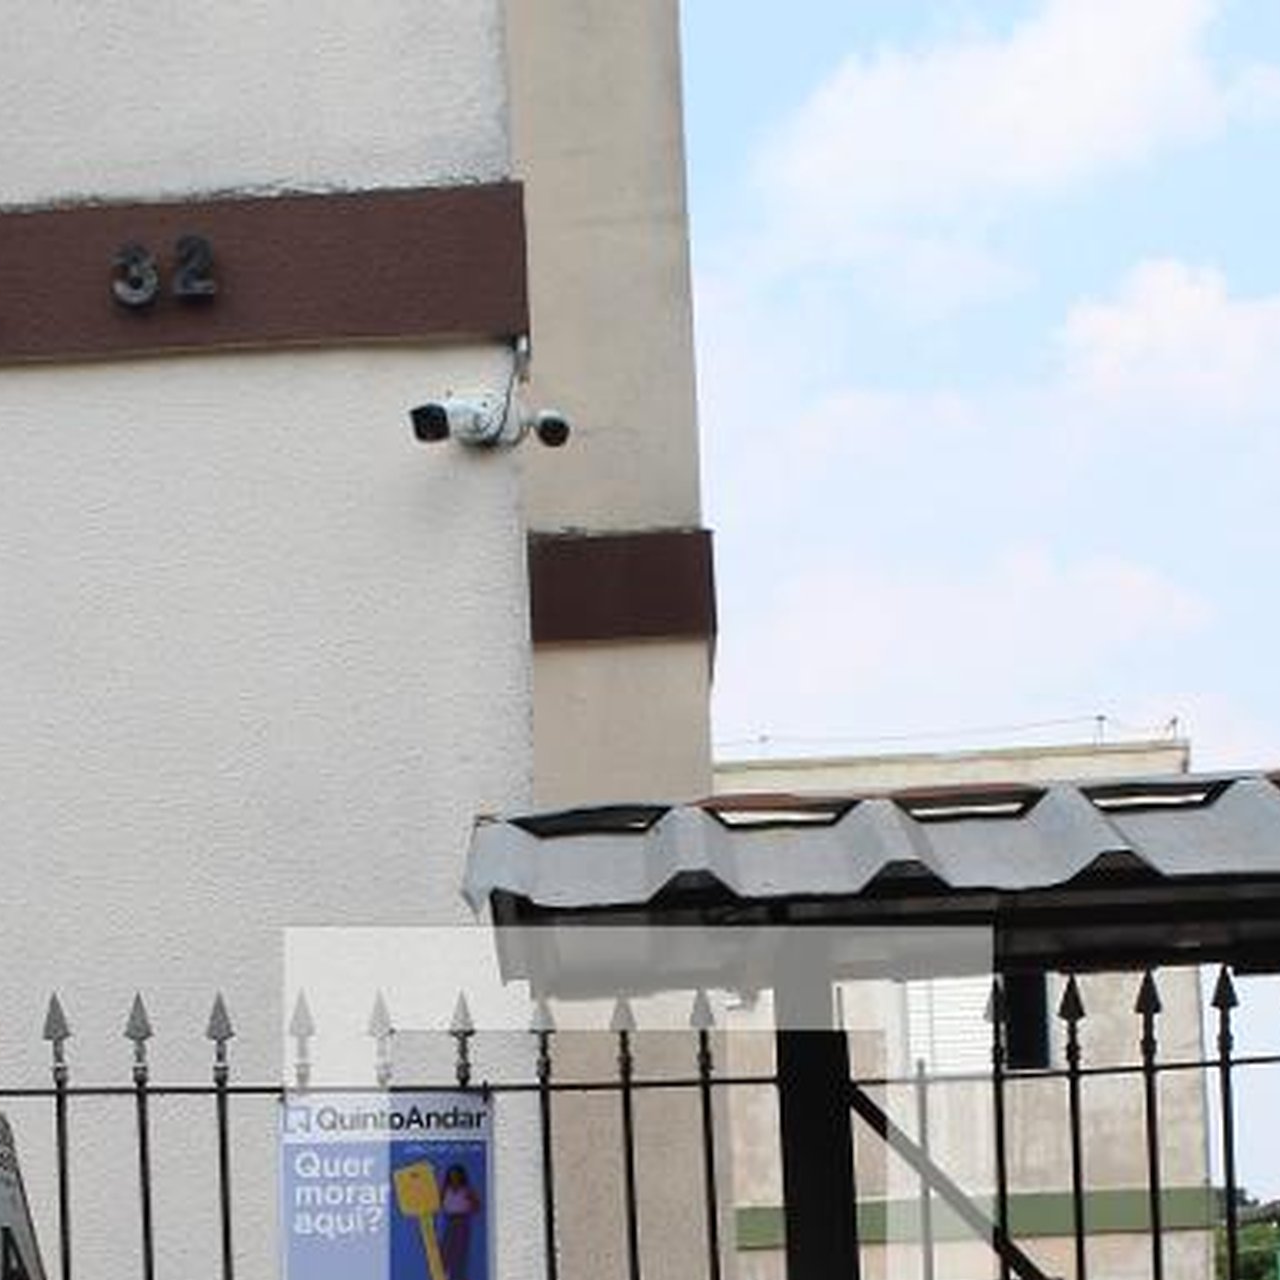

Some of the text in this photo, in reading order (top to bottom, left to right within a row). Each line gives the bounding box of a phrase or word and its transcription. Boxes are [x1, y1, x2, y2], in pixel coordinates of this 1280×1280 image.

[113, 236, 217, 305] 32
[317, 1106, 487, 1131] QuintoAndar
[295, 1151, 374, 1178] Quer
[295, 1185, 389, 1206] morar
[294, 1208, 383, 1238] aqui?
